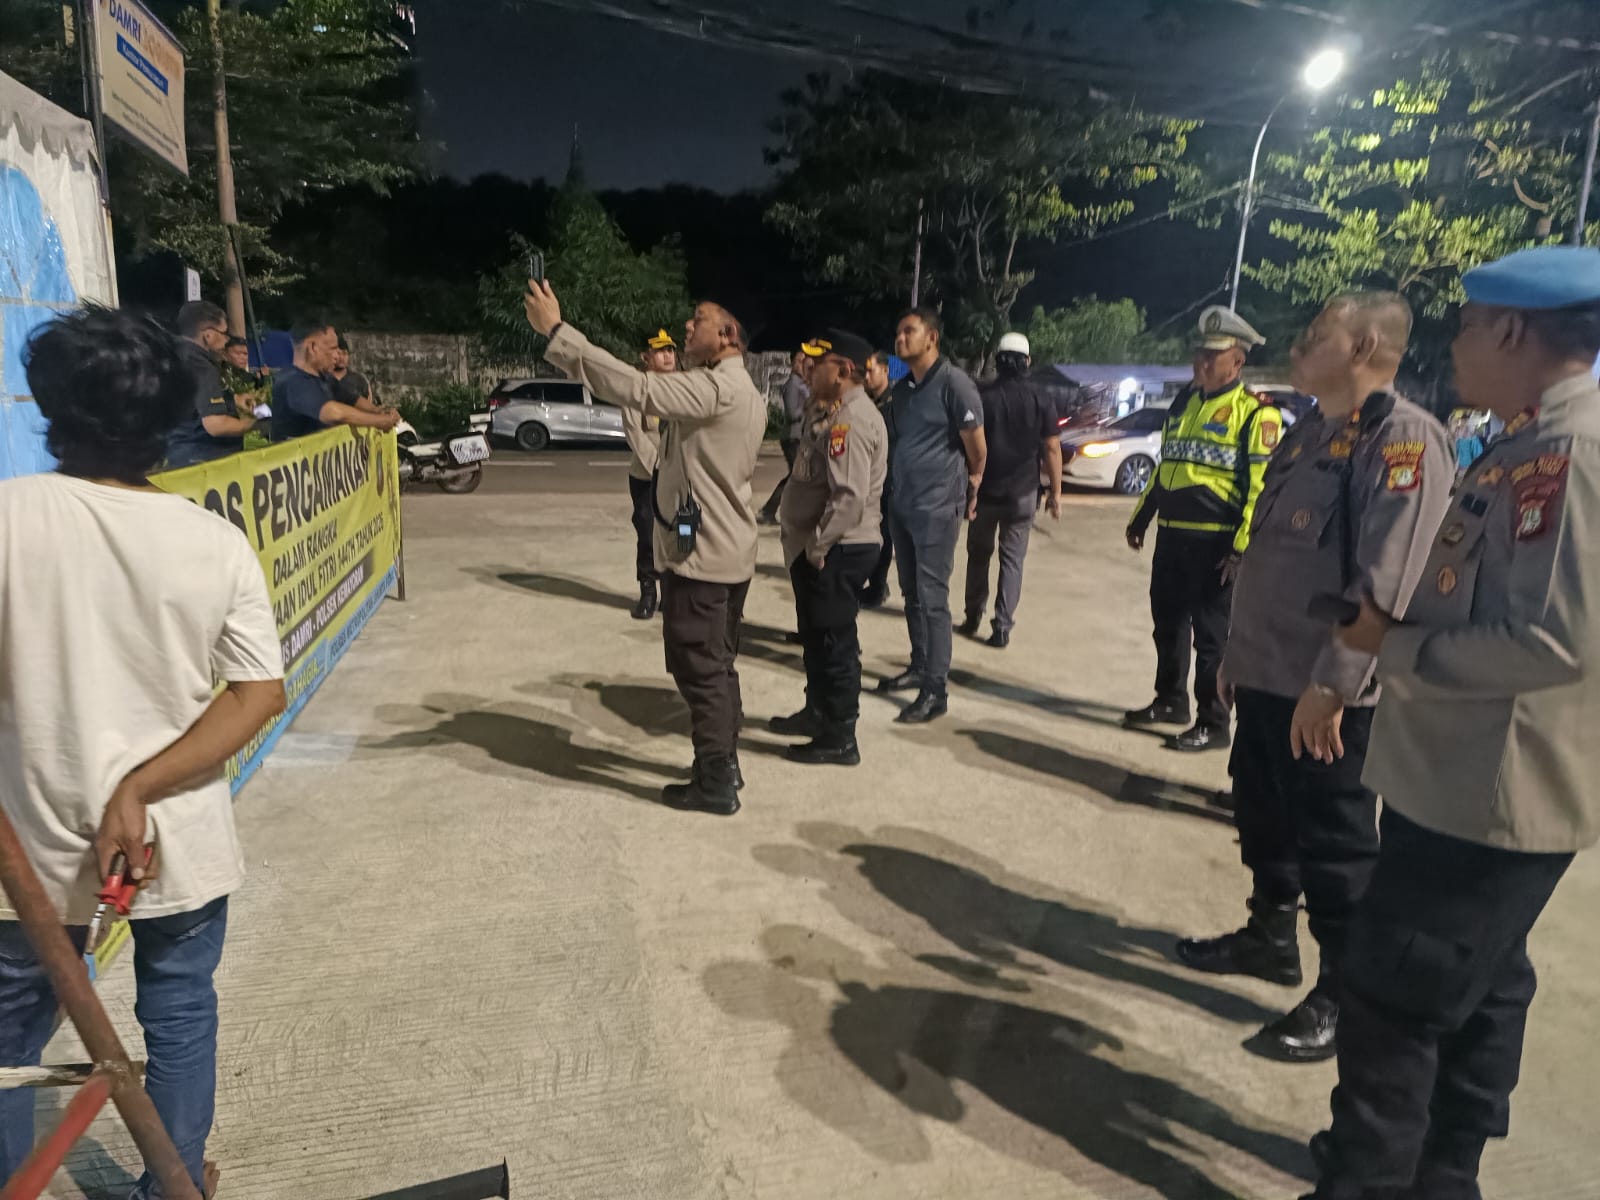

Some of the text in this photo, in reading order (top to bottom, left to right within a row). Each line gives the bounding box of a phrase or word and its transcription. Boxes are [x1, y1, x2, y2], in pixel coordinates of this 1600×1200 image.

[109, 0, 141, 44] DAMRI
[253, 434, 370, 550] PENGAMANAN
[273, 518, 337, 589] DALAM RANGKA
[298, 571, 318, 610] IDUL
[318, 552, 337, 590] FITRI
[355, 522, 374, 553] TAHUN
[291, 617, 313, 658] DAMRI
[315, 590, 338, 631] POLSEK
